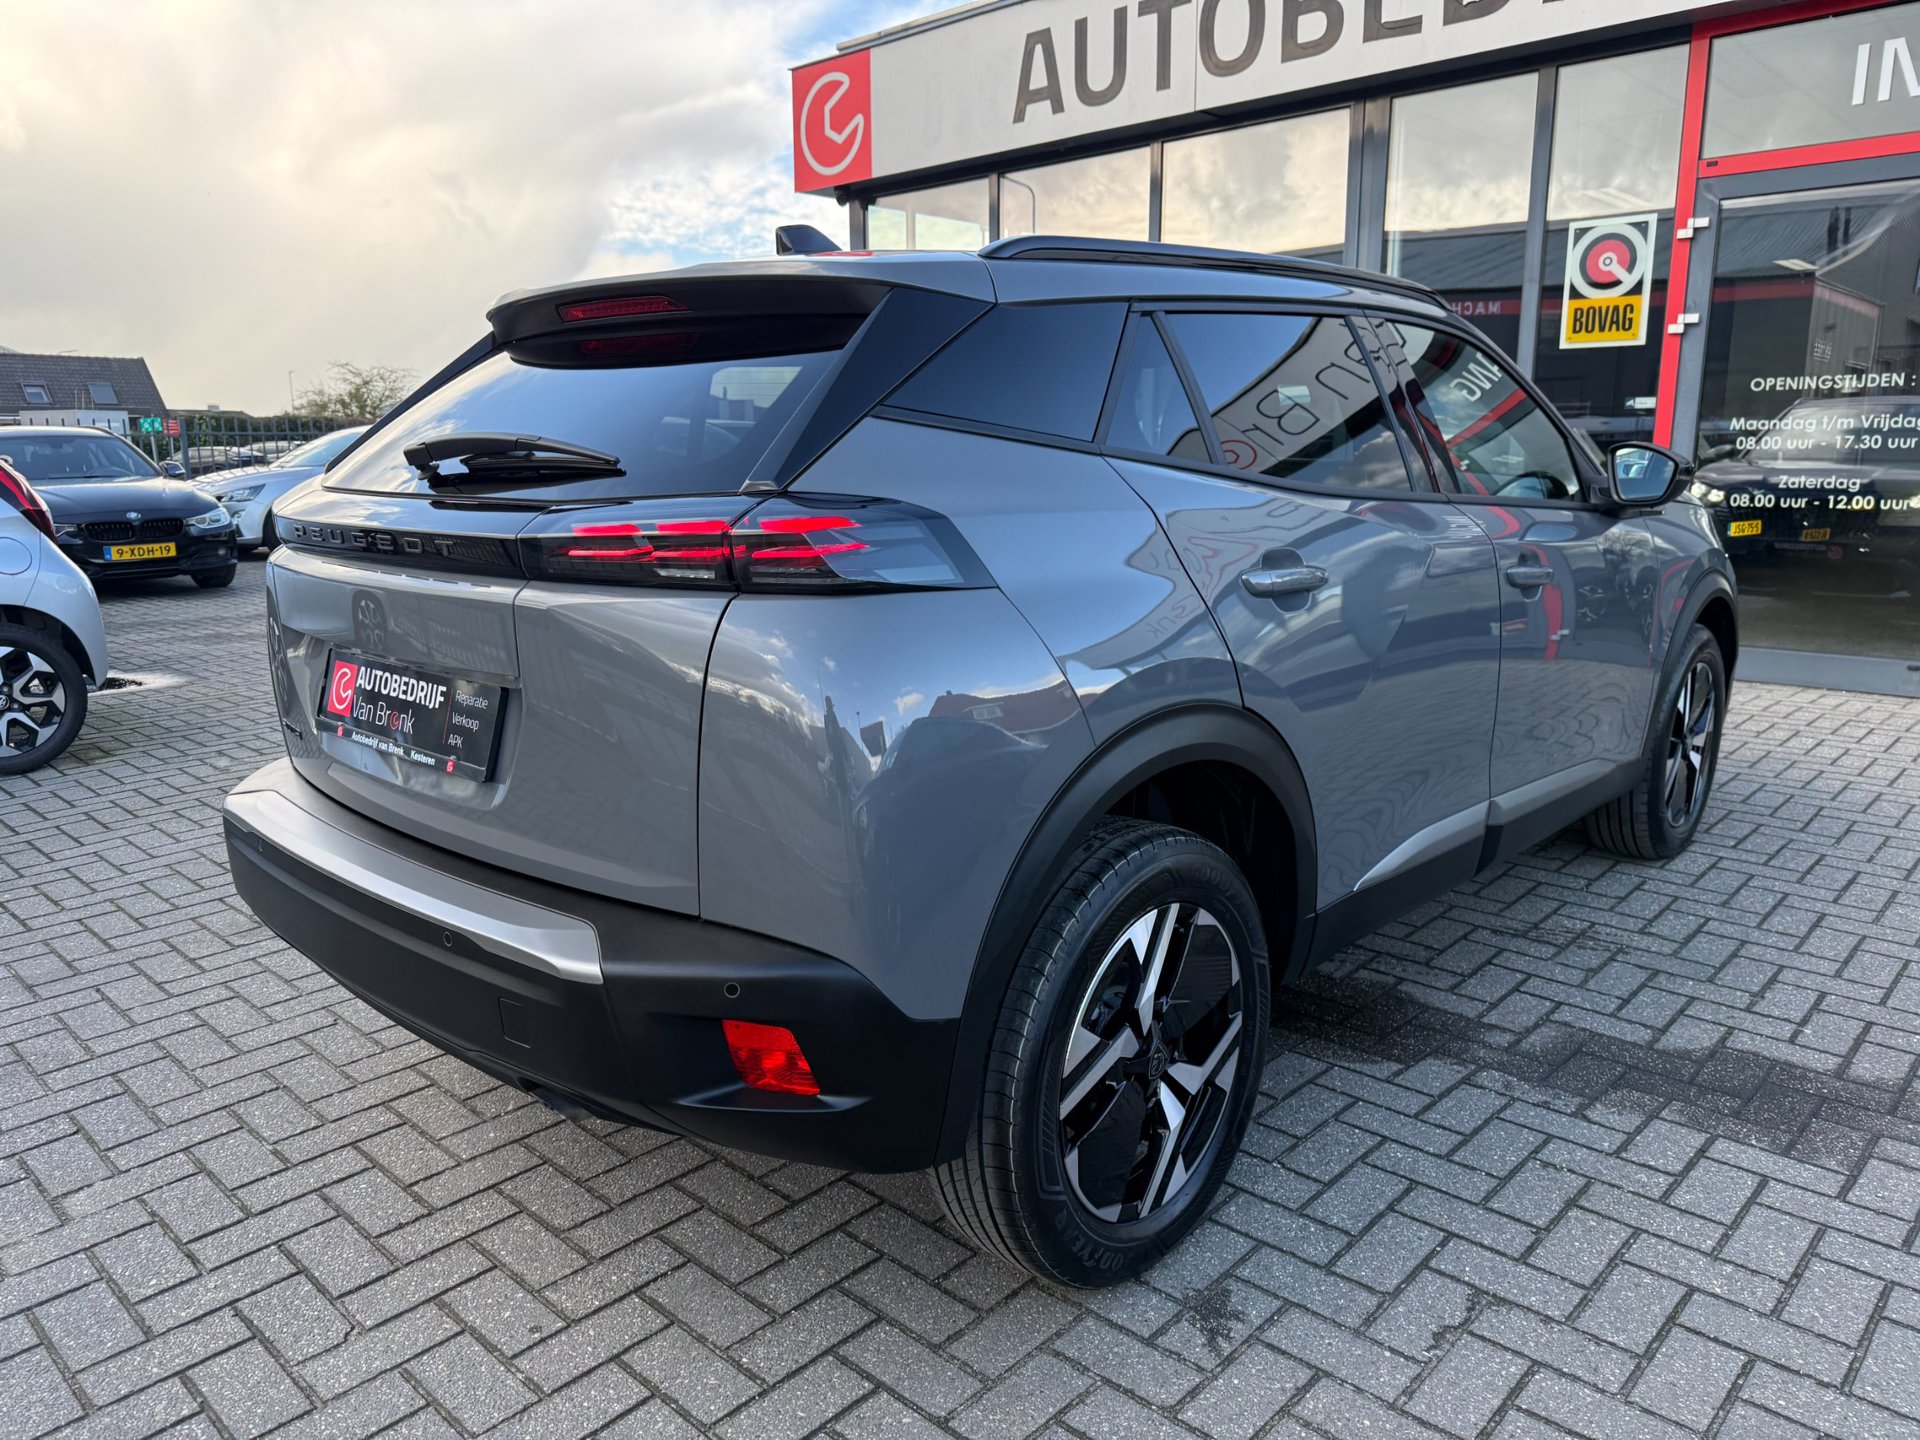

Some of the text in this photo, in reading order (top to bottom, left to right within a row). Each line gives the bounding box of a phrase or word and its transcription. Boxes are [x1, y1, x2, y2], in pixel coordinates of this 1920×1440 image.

[1572, 303, 1635, 334] BOVAG
[1750, 372, 1905, 392] OPENINGSTIJDEN
[1729, 416, 1817, 433] Maandag
[1822, 415, 1855, 432] t/m
[1735, 436, 1782, 450] 08.00
[1786, 438, 1815, 450] uur
[1835, 435, 1882, 450] 17.30
[1887, 437, 1918, 449] uur
[1778, 475, 1861, 492] Zaterdag
[1729, 494, 1775, 508] 08.00
[1780, 496, 1808, 509] uur
[1827, 495, 1874, 510] 12.00
[1879, 497, 1912, 511] uur
[293, 524, 454, 557] PEUGEOT
[116, 545, 171, 558] 9-XDH-19
[356, 666, 447, 709] AUTOBEDRIJF
[352, 695, 374, 722] Van
[455, 690, 489, 710] Reparatie
[452, 711, 480, 733] Verkoop
[351, 731, 379, 749] Autobedrijf
[388, 742, 404, 756] Brenk
[410, 750, 436, 766] Kesteren
[447, 733, 464, 749] APK
